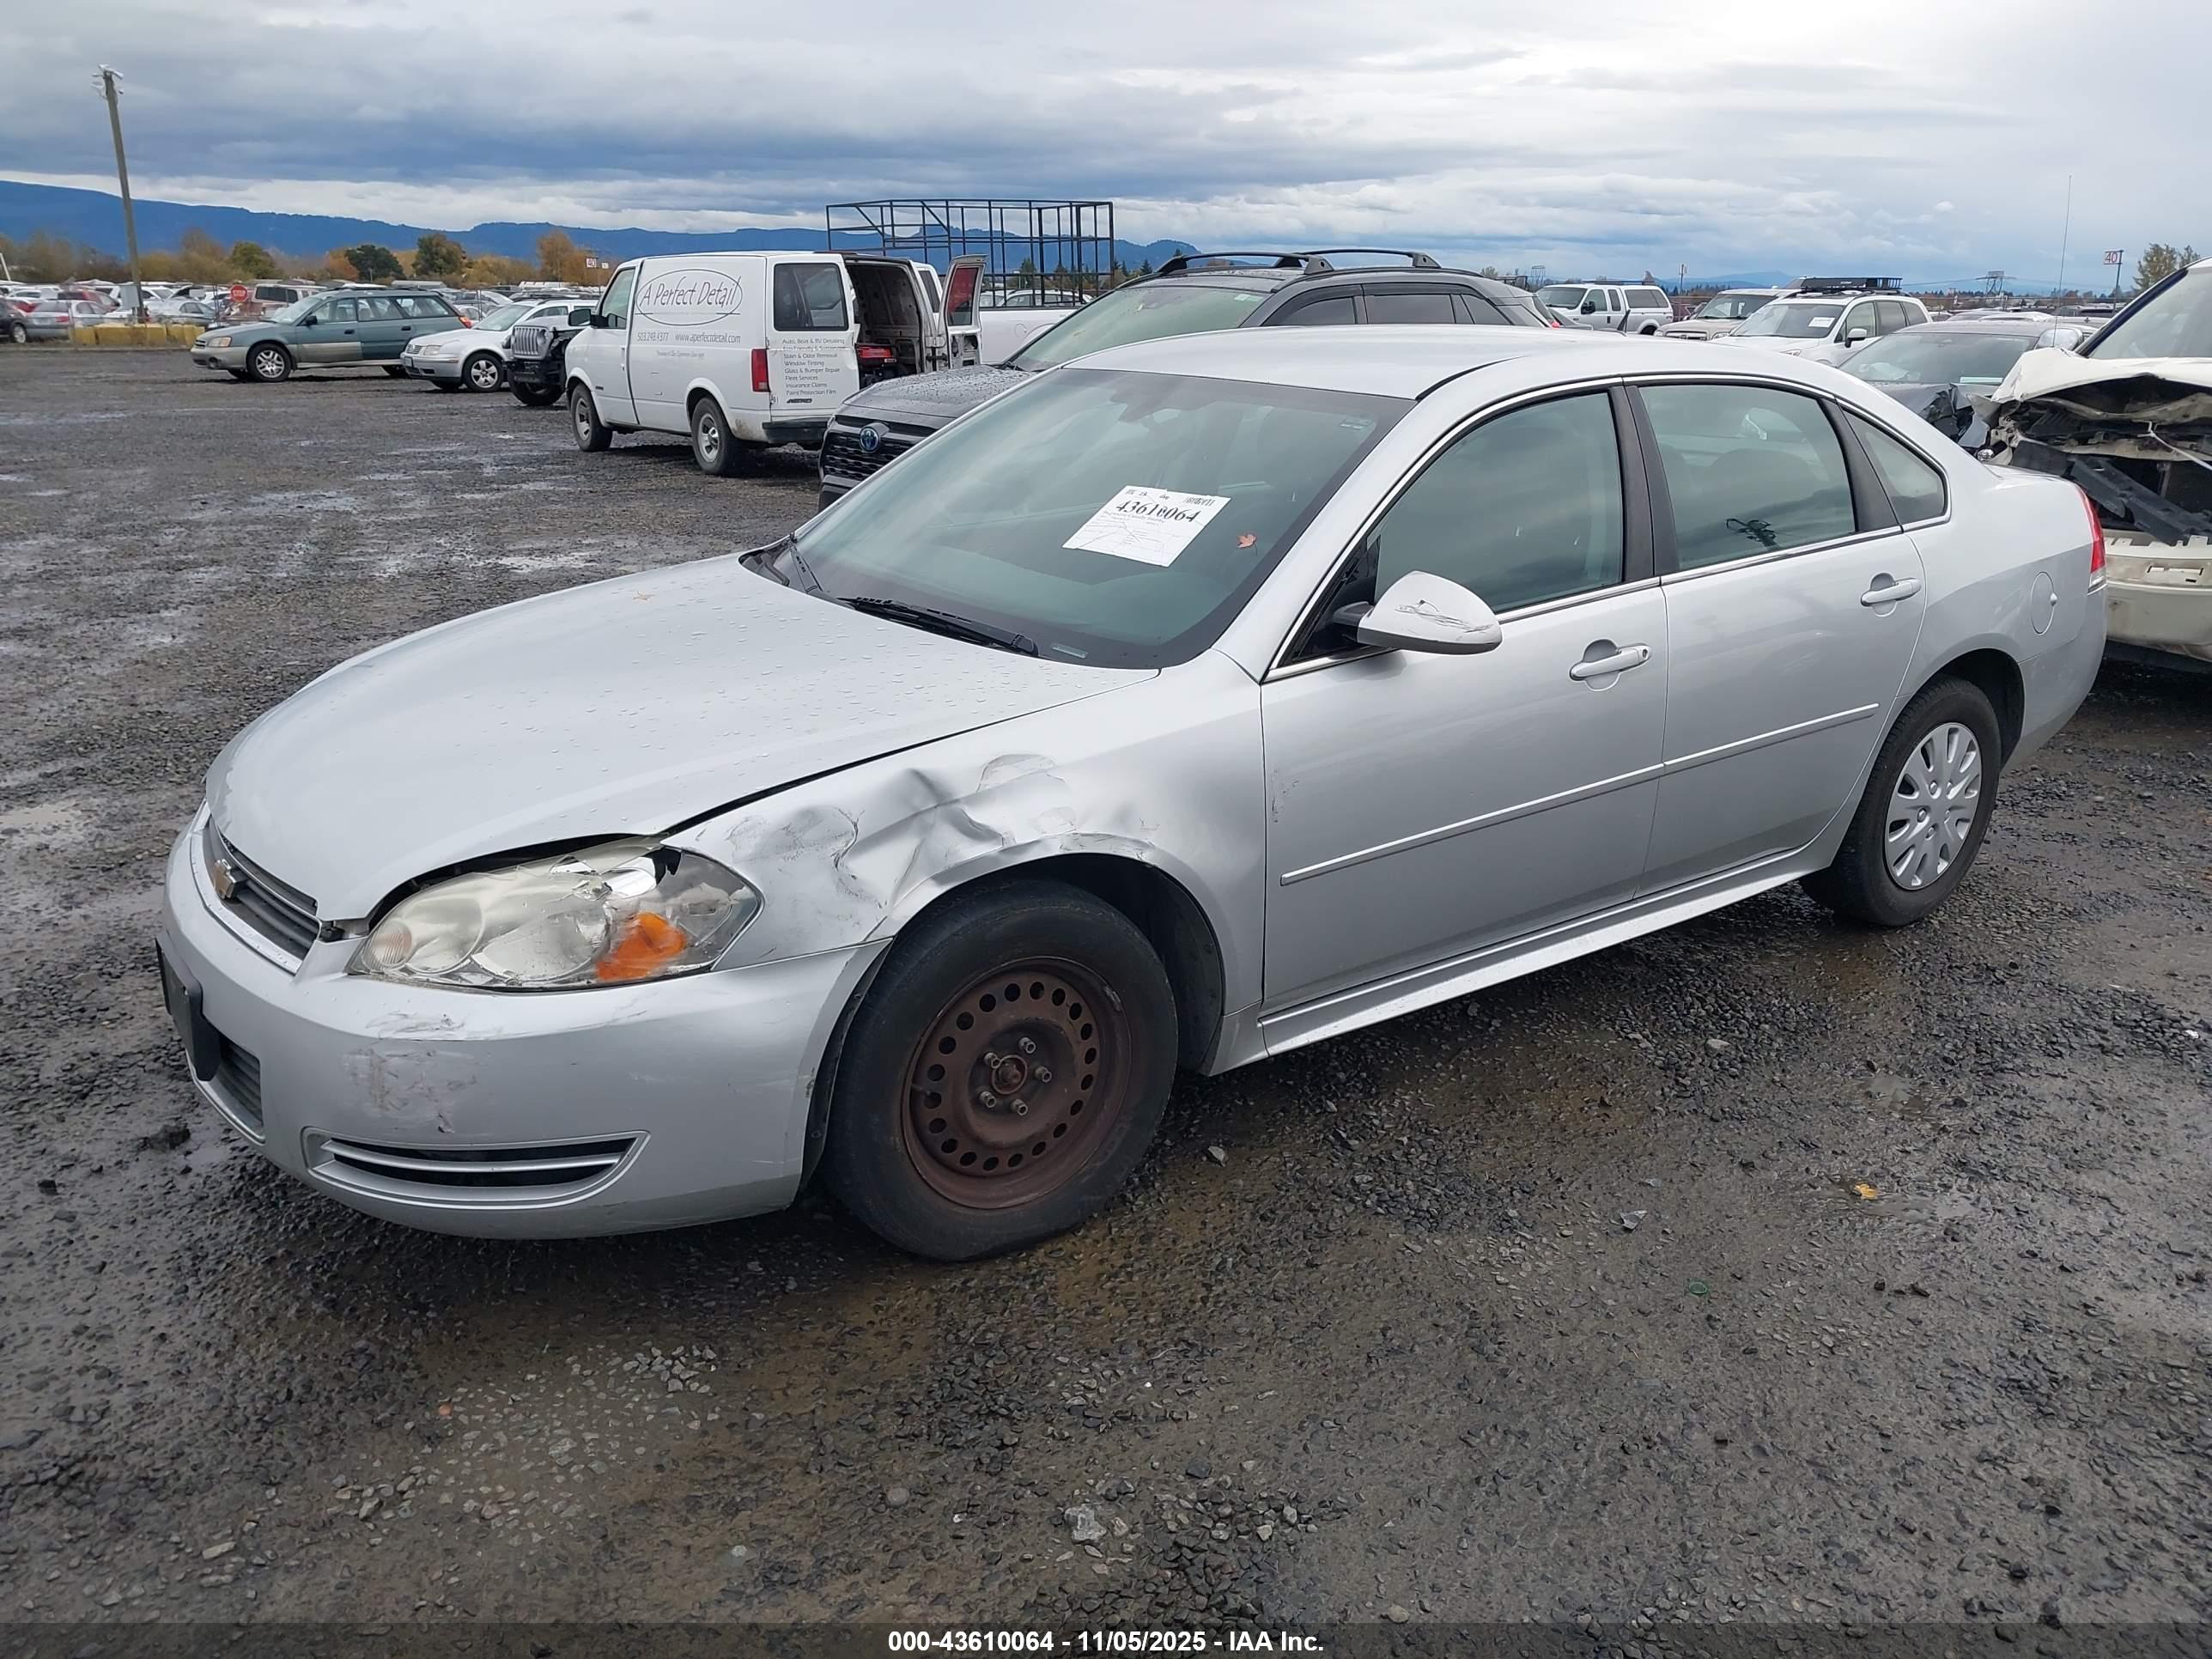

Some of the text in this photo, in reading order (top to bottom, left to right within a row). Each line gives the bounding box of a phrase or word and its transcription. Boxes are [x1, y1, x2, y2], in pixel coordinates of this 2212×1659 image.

[2105, 252, 2118, 263] 40
[639, 276, 742, 308] A Perfect Detail
